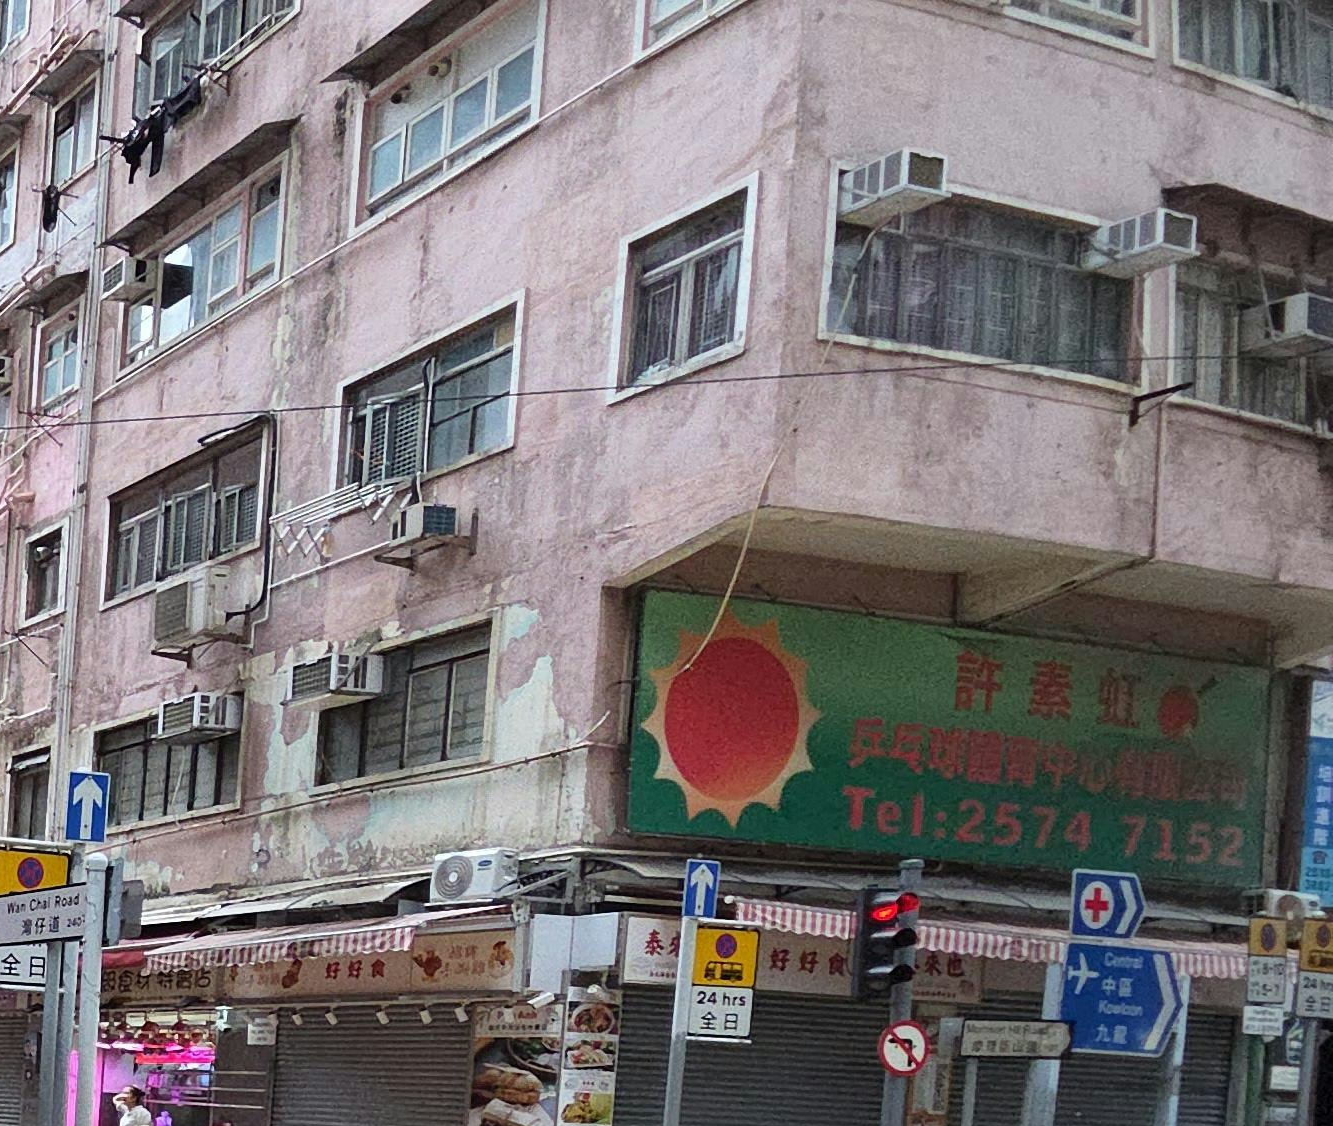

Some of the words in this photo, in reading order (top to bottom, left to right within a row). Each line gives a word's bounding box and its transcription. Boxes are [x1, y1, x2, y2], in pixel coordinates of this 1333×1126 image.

[1122, 814, 1245, 867] 7152
[7, 901, 27, 914] Wan
[29, 897, 51, 912] Chai
[54, 893, 80, 908] Road
[21, 914, 60, 936] 灣仔道
[0, 952, 45, 979] 全日
[324, 958, 386, 981] 好好食
[769, 947, 848, 977] 好好食
[1101, 975, 1135, 998] 中區
[696, 990, 718, 1006] 24
[722, 991, 746, 1007] hrs
[700, 1011, 739, 1031] 全日
[1095, 1023, 1129, 1045] 九龍
